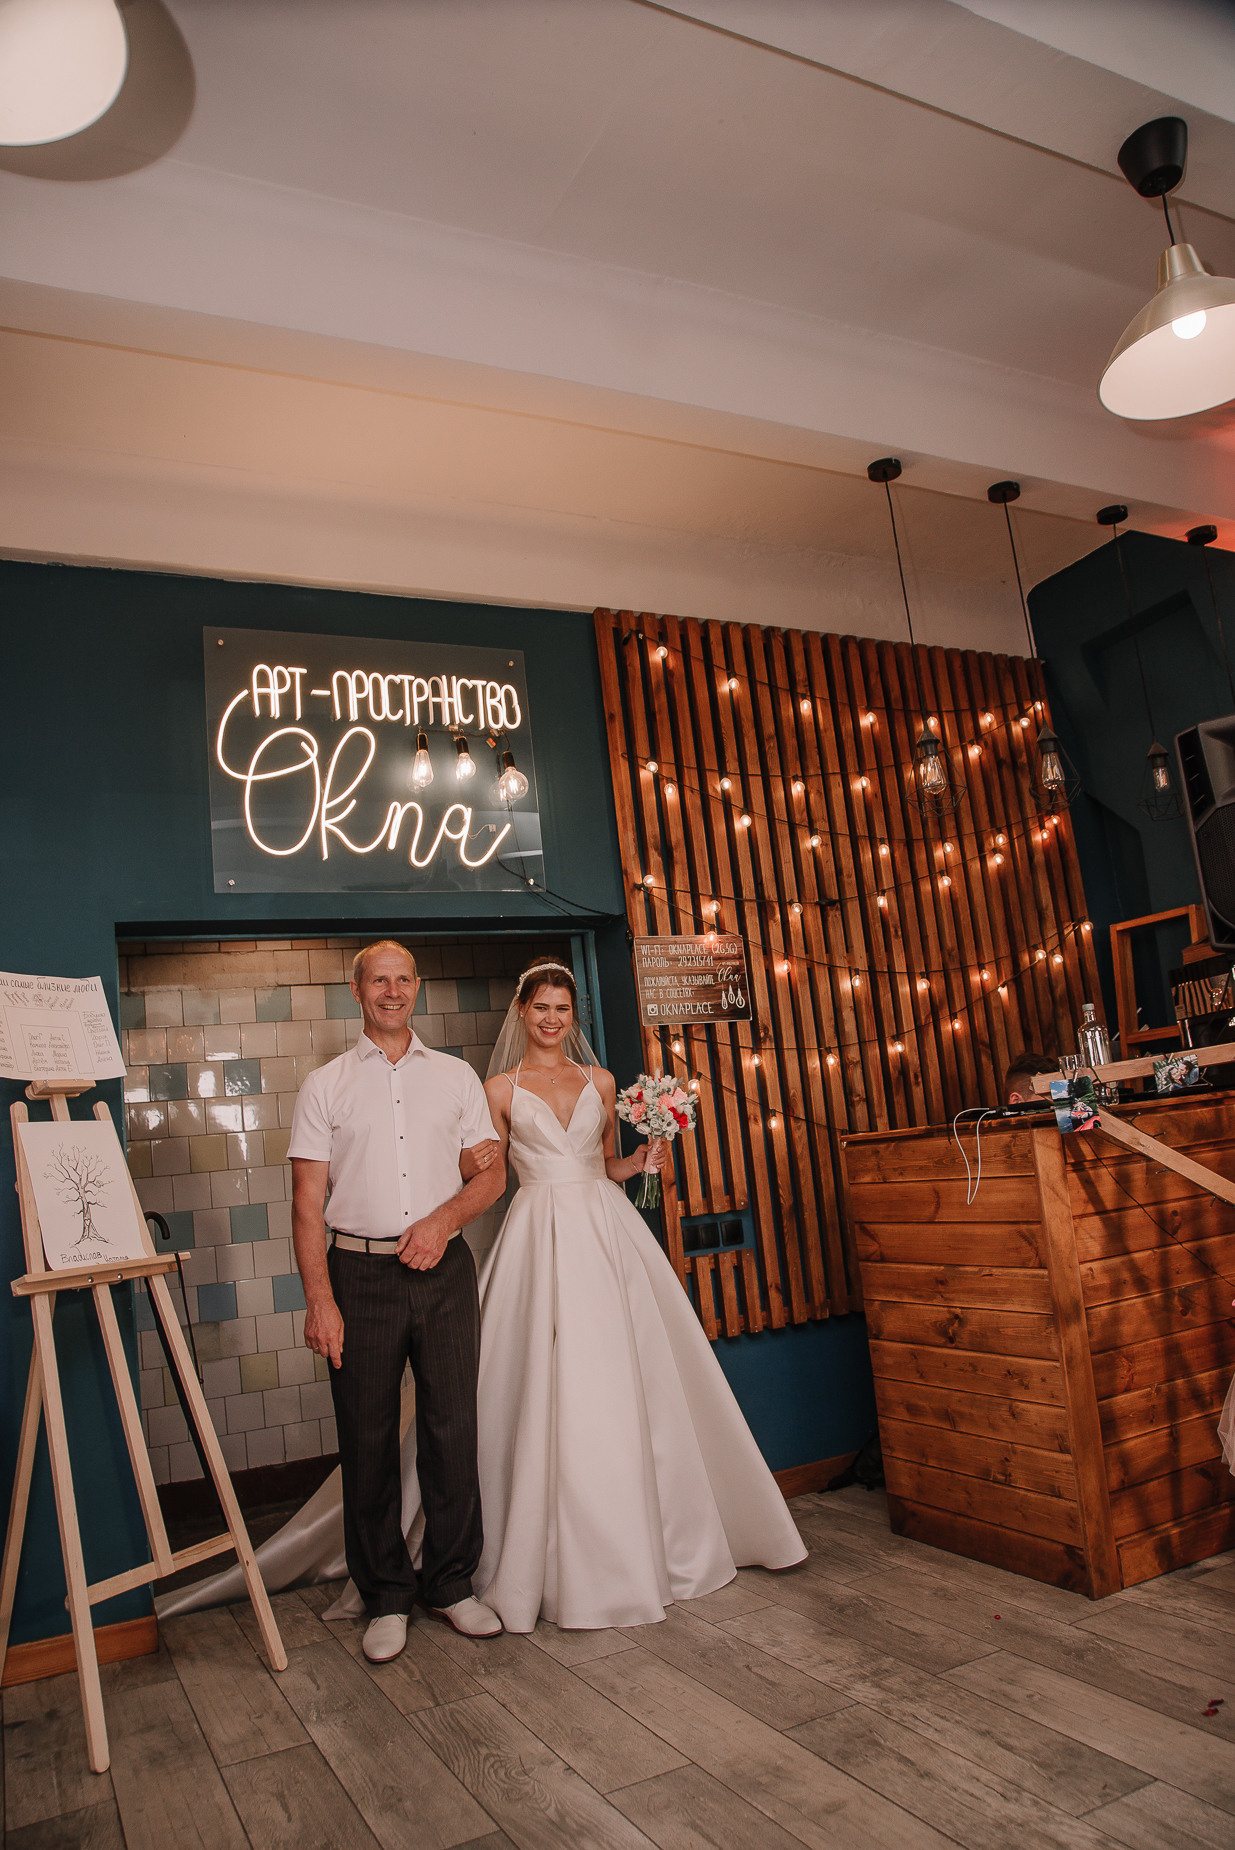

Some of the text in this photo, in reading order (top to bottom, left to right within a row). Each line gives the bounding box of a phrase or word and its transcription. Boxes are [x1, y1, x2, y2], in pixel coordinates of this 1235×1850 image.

[217, 689, 512, 867] Okna
[668, 943, 708, 955] OKNAPLACE
[659, 989, 664, 998] В
[660, 1001, 715, 1016] OKNAPLACE
